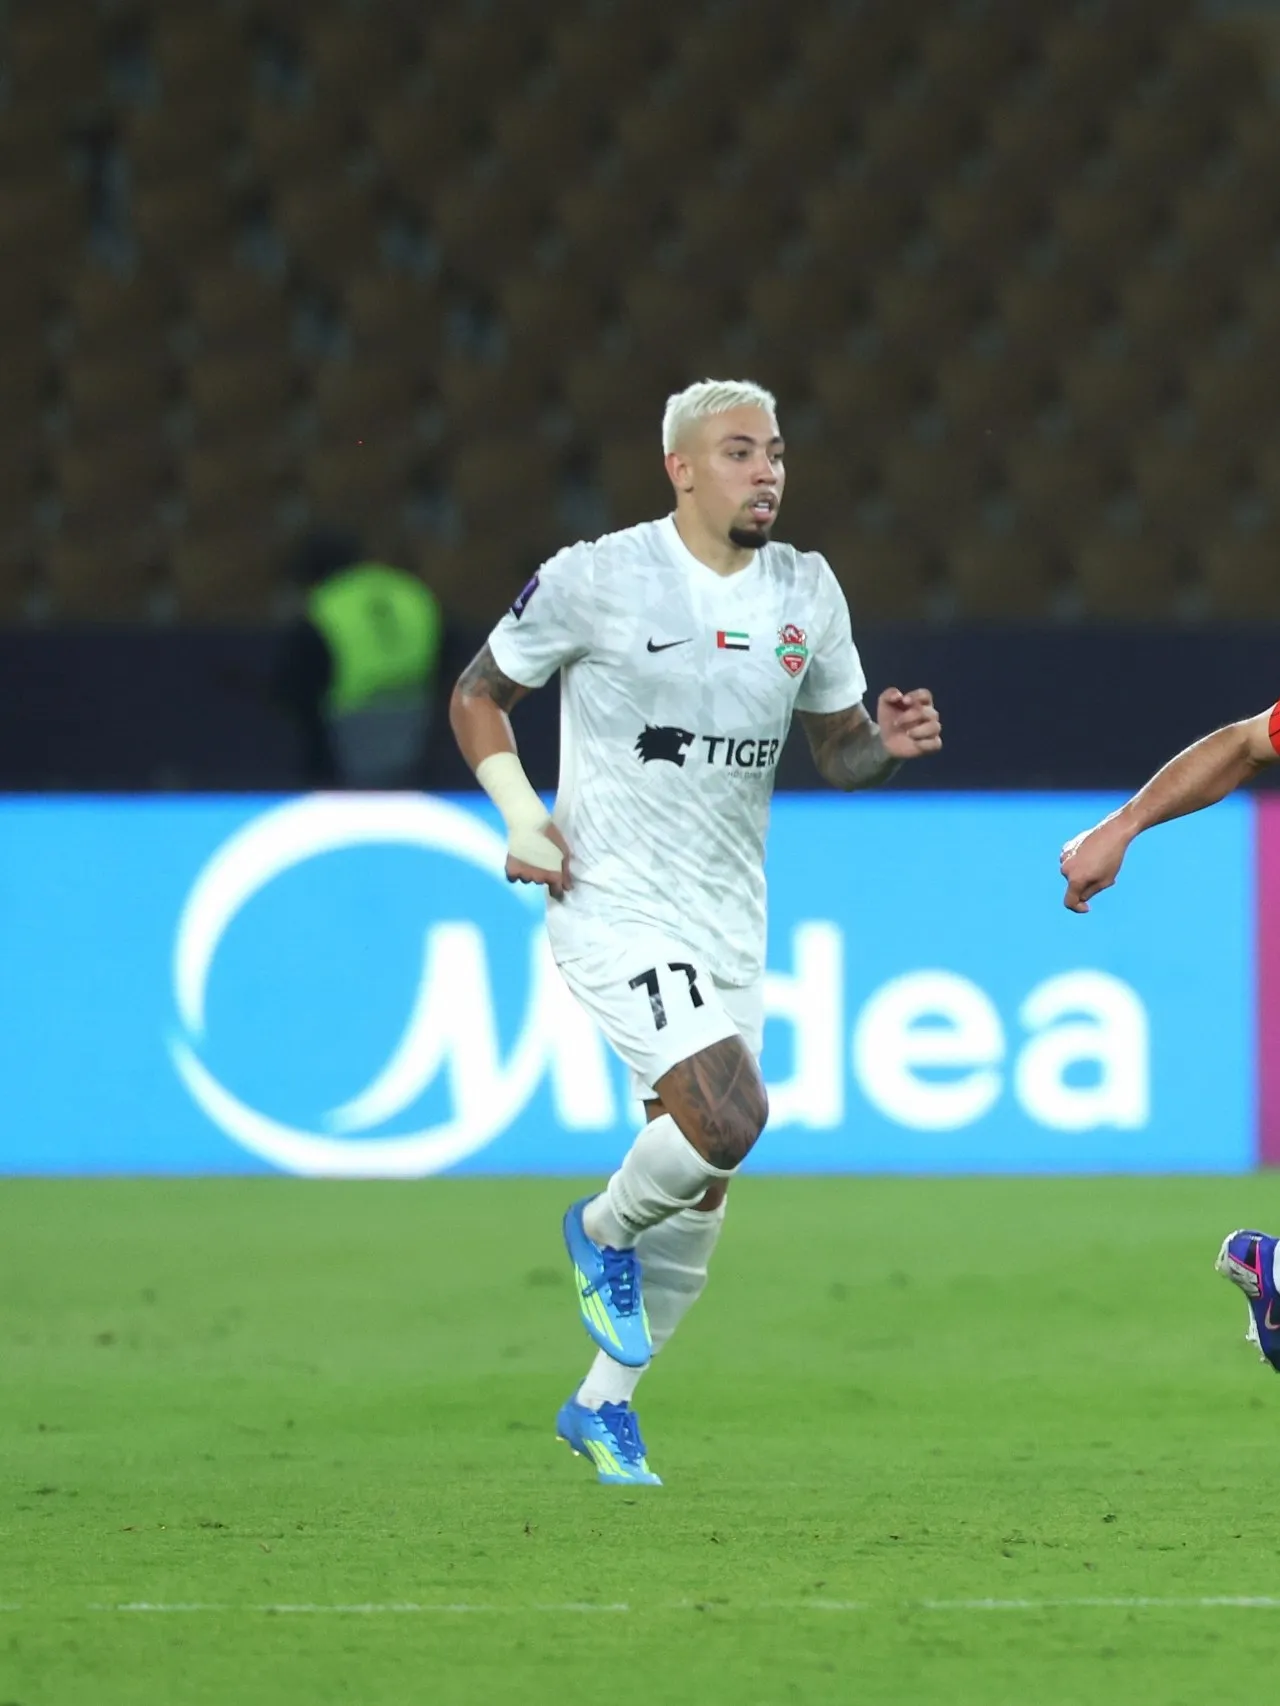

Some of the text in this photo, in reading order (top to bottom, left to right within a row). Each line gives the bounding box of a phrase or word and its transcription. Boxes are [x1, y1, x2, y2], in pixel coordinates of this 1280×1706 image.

[702, 735, 779, 767] TIGER
[320, 919, 1150, 1132] Mdea
[628, 962, 704, 1031] 77
